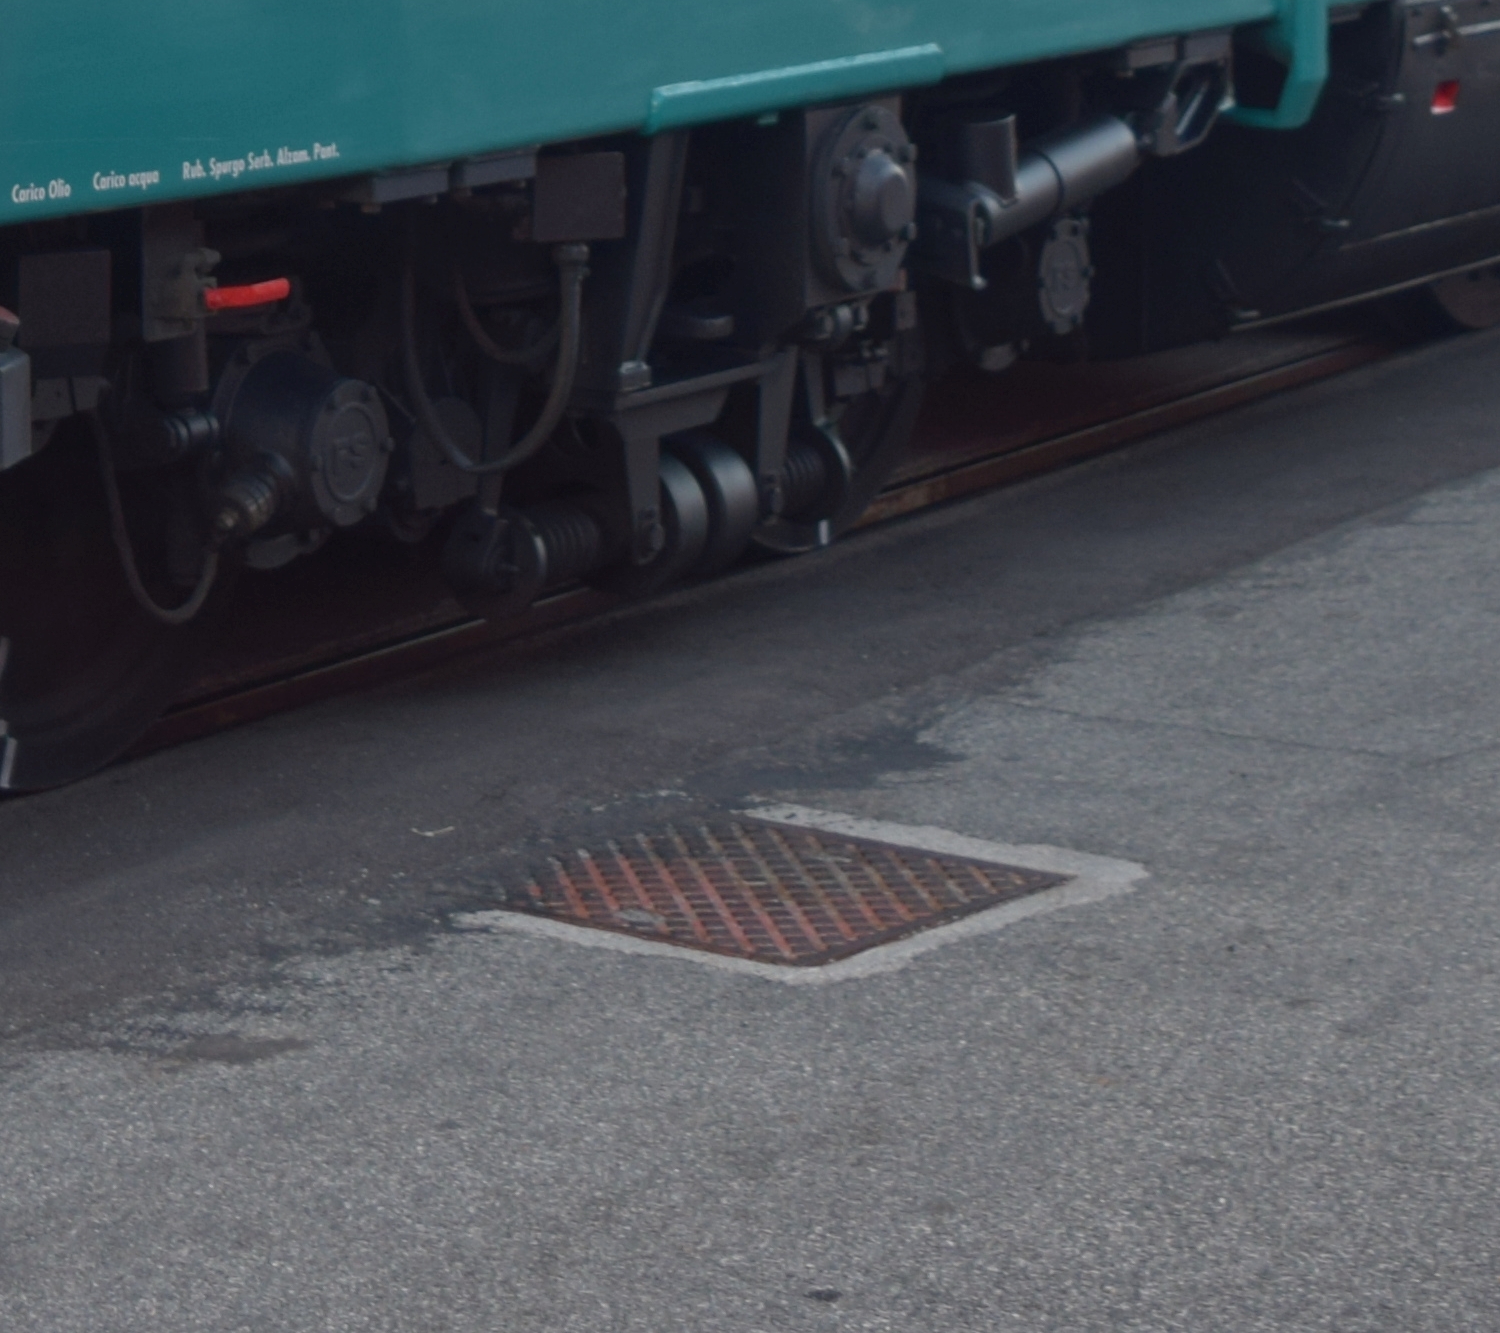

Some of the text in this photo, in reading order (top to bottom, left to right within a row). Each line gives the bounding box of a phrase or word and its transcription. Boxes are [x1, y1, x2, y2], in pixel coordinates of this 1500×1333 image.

[93, 170, 160, 190] Carico acqua
[209, 157, 245, 180] Spurgo
[12, 179, 71, 203] Carico Olio
